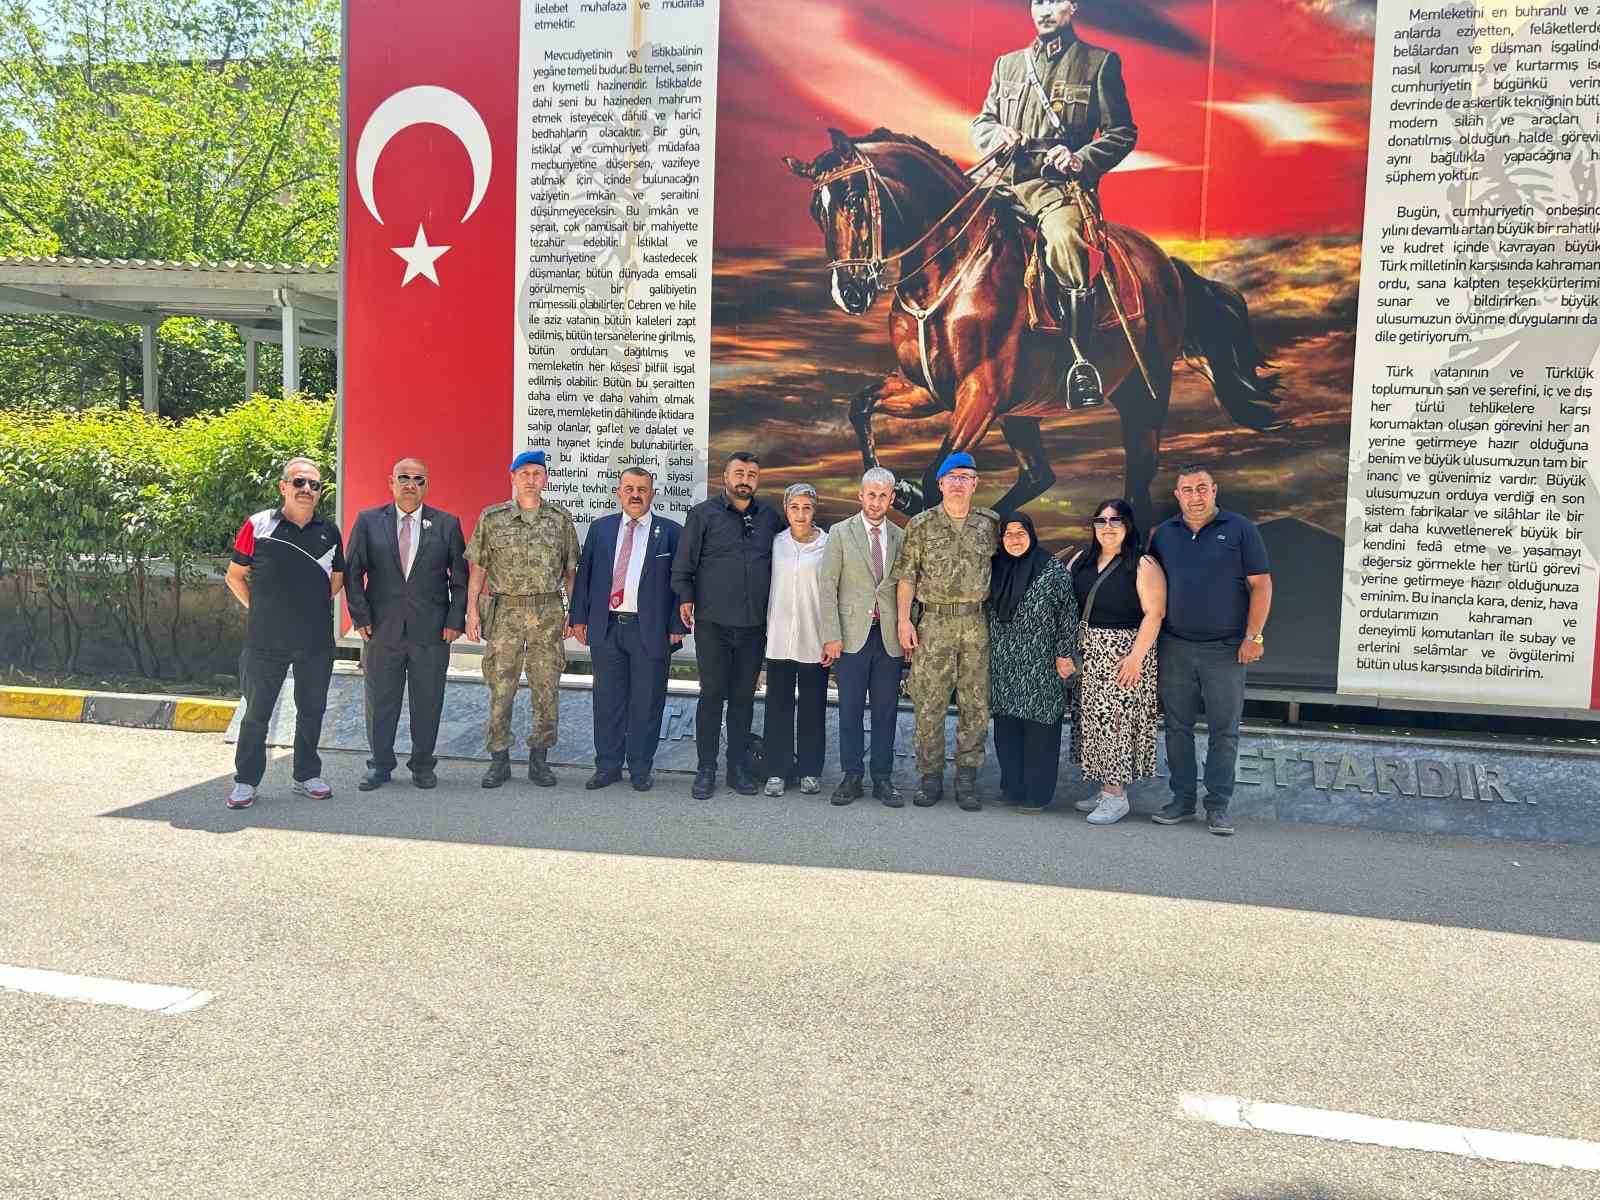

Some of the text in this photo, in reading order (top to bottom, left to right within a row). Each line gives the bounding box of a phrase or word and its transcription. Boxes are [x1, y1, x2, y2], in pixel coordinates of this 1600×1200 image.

[535, 3, 568, 14] ilelebet
[1492, 9, 1507, 18] en
[1516, 5, 1566, 17] buhranlı
[1574, 7, 1589, 15] ve
[1394, 26, 1440, 39] anlarda
[1468, 46, 1482, 54] ve
[567, 61, 702, 76] temeli senin
[1393, 63, 1507, 74] nasıl ve
[1494, 78, 1547, 93] bugünkü
[532, 93, 701, 108] dahi seni hazineden mahrum
[1391, 96, 1512, 110] devrinde de askerlik
[532, 110, 613, 125] etmek isteyecek
[1390, 116, 1514, 128] modern ve
[1519, 132, 1553, 143] halde
[532, 141, 700, 154] istiklal müdafaa
[662, 157, 700, 170] vazifeye
[1386, 156, 1411, 166] aynı
[530, 189, 569, 203] vaziyetin
[585, 221, 698, 234] namüsait mahiyette
[1382, 224, 1554, 239] yılını devamlı artan büyük bir
[530, 237, 565, 247] tezahür
[1381, 241, 1555, 255] ve kudret kavrayan
[643, 252, 697, 263] kastedecek
[1380, 259, 1466, 271] Türk milletinin
[586, 267, 696, 280] bütün dünyada emsali
[611, 283, 696, 297] bir galibiyetin
[1417, 277, 1499, 291] sana kalpten
[529, 299, 696, 310] mümessili Cebren ve hile
[1377, 298, 1450, 306] sunar ve
[529, 313, 696, 328] ile aziz vatanın bütün kaleleri zapt
[1377, 313, 1597, 325] ulusumuzun övünme da
[566, 329, 657, 342] bütün tersanelerine
[1375, 330, 1397, 342] dile
[529, 344, 554, 356] bütün
[571, 345, 607, 357] orduları
[529, 359, 668, 373] memleketin her bilfiil
[1387, 366, 1594, 378] Türk vatanının ve Türklük
[603, 376, 648, 388] Bütün bu
[528, 390, 694, 404] daha elim ve daha vahim olmak
[1372, 383, 1571, 398] toplumunun ve ve
[1371, 401, 1444, 412] her türlü
[557, 407, 694, 420] memleketin iktidara
[528, 421, 552, 435] sahip
[597, 423, 623, 436] gaflet
[629, 425, 640, 434] ve
[646, 423, 677, 435] dalalet
[1370, 418, 1589, 434] korumaktan görevini her an
[528, 436, 590, 450] hatta hıyanet
[1369, 436, 1519, 451] yerine getirmeye hazır
[560, 452, 571, 462] bu
[580, 452, 609, 463] iktidar
[1368, 453, 1588, 468] benim ve büyük ulusumuzun tam bir
[667, 471, 692, 484] siyasi
[1407, 472, 1586, 489] ve güvenimiz Büyük
[1367, 488, 1584, 504] ulusumuzun orduya en son
[1365, 505, 1584, 522] sistem fabrikalar ve ile bir
[1365, 522, 1583, 541] kat daha büyük bir
[1364, 539, 1486, 553] kendini etme
[1417, 558, 1581, 577] görmekle her türlü görevi
[1361, 573, 1502, 590] yerine getirmeye hazır
[1550, 598, 1578, 609] hava
[1468, 612, 1532, 625] kahraman
[1359, 625, 1557, 647] deneyimli ile subay
[1358, 642, 1574, 665] erlerini övgülerimi
[1357, 658, 1418, 672] bütün ulus
